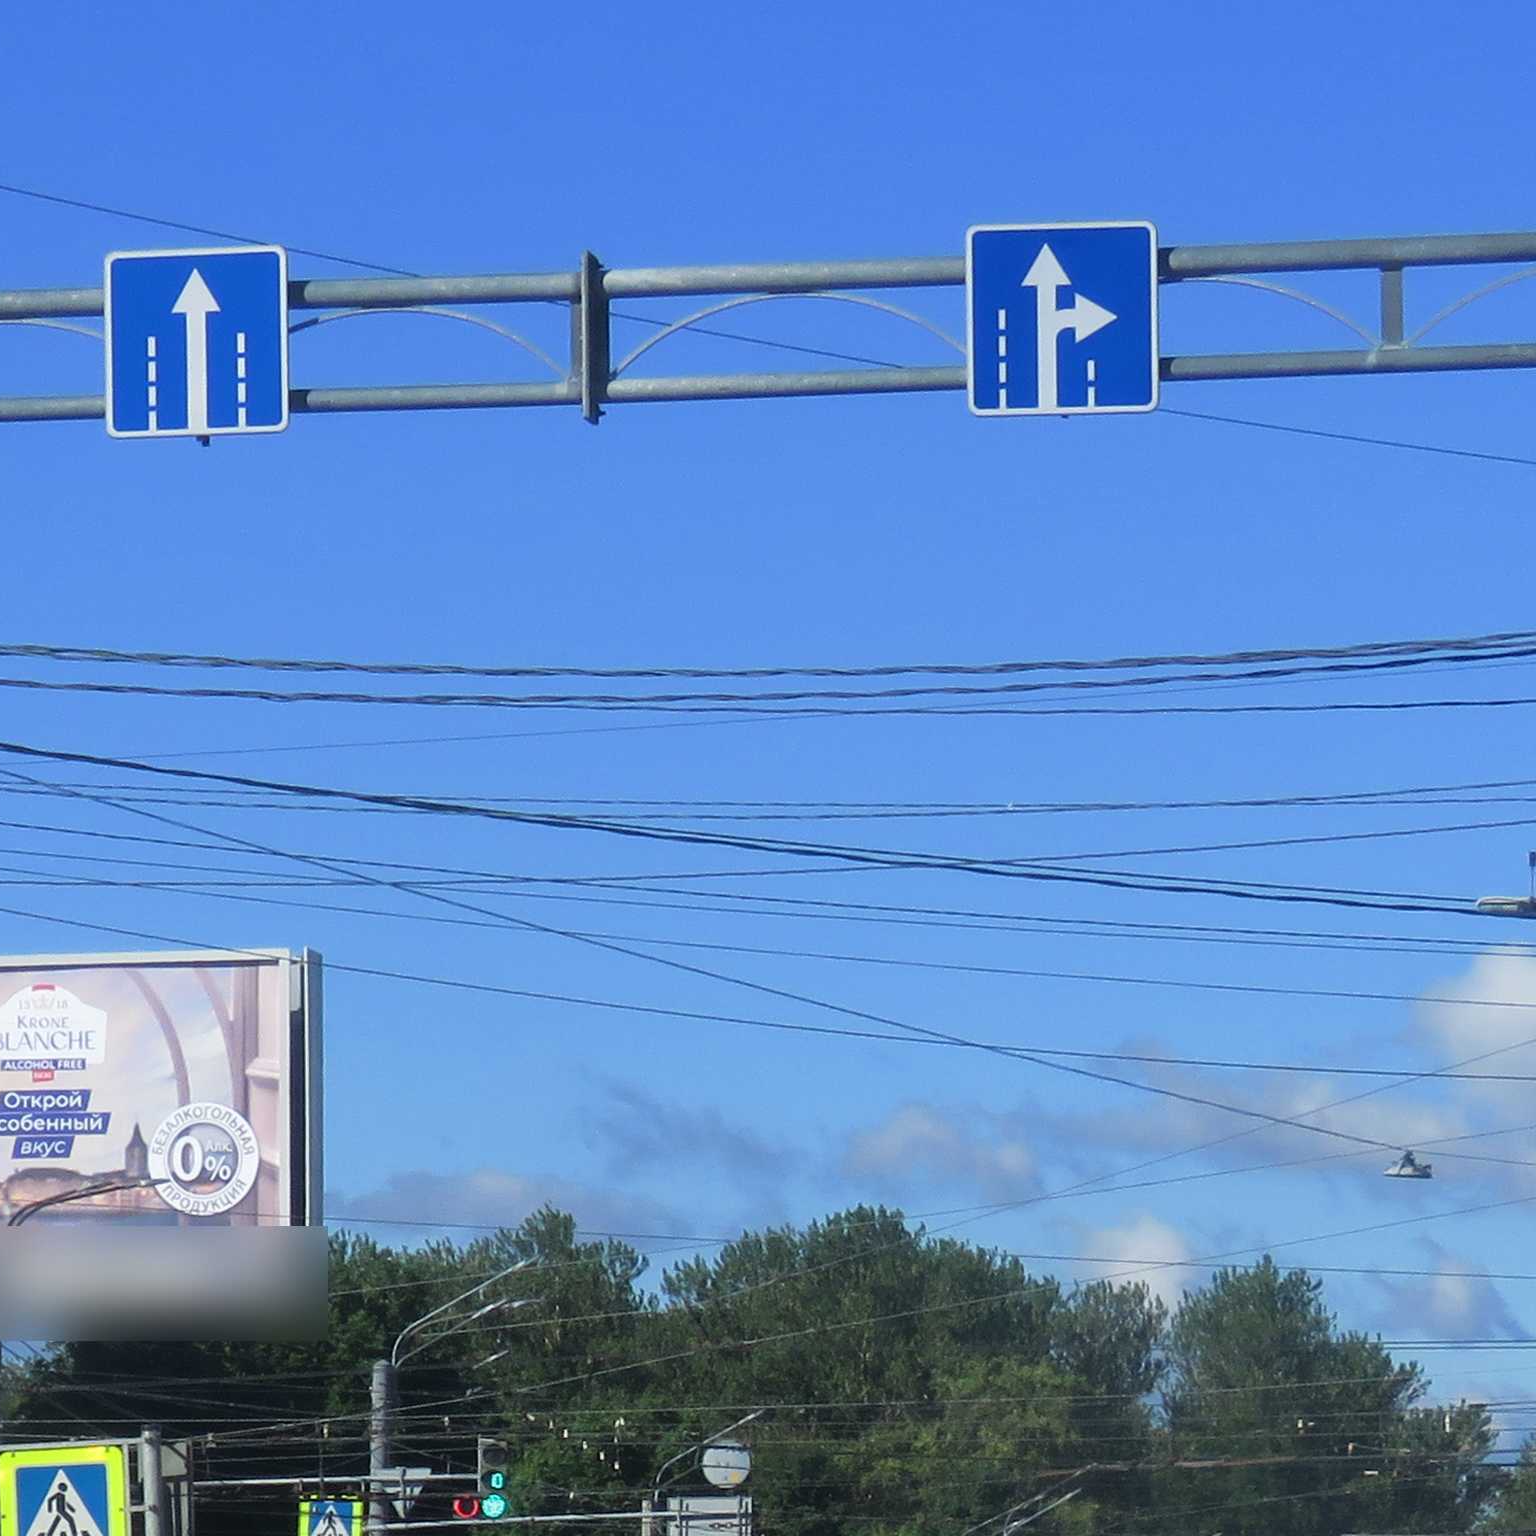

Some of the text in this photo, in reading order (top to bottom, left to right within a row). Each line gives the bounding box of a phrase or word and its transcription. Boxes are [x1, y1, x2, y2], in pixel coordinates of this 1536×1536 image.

[16, 1015, 70, 1029] KRONE
[4, 1059, 84, 1070] ALCOHOL FREE
[4, 1091, 82, 1111] Открой
[152, 1105, 256, 1156] БЕЗАЛКОГОЛЬНАЯ
[20, 1141, 66, 1158] вкус
[162, 1178, 247, 1213] ПРОДУКЦИЯ
